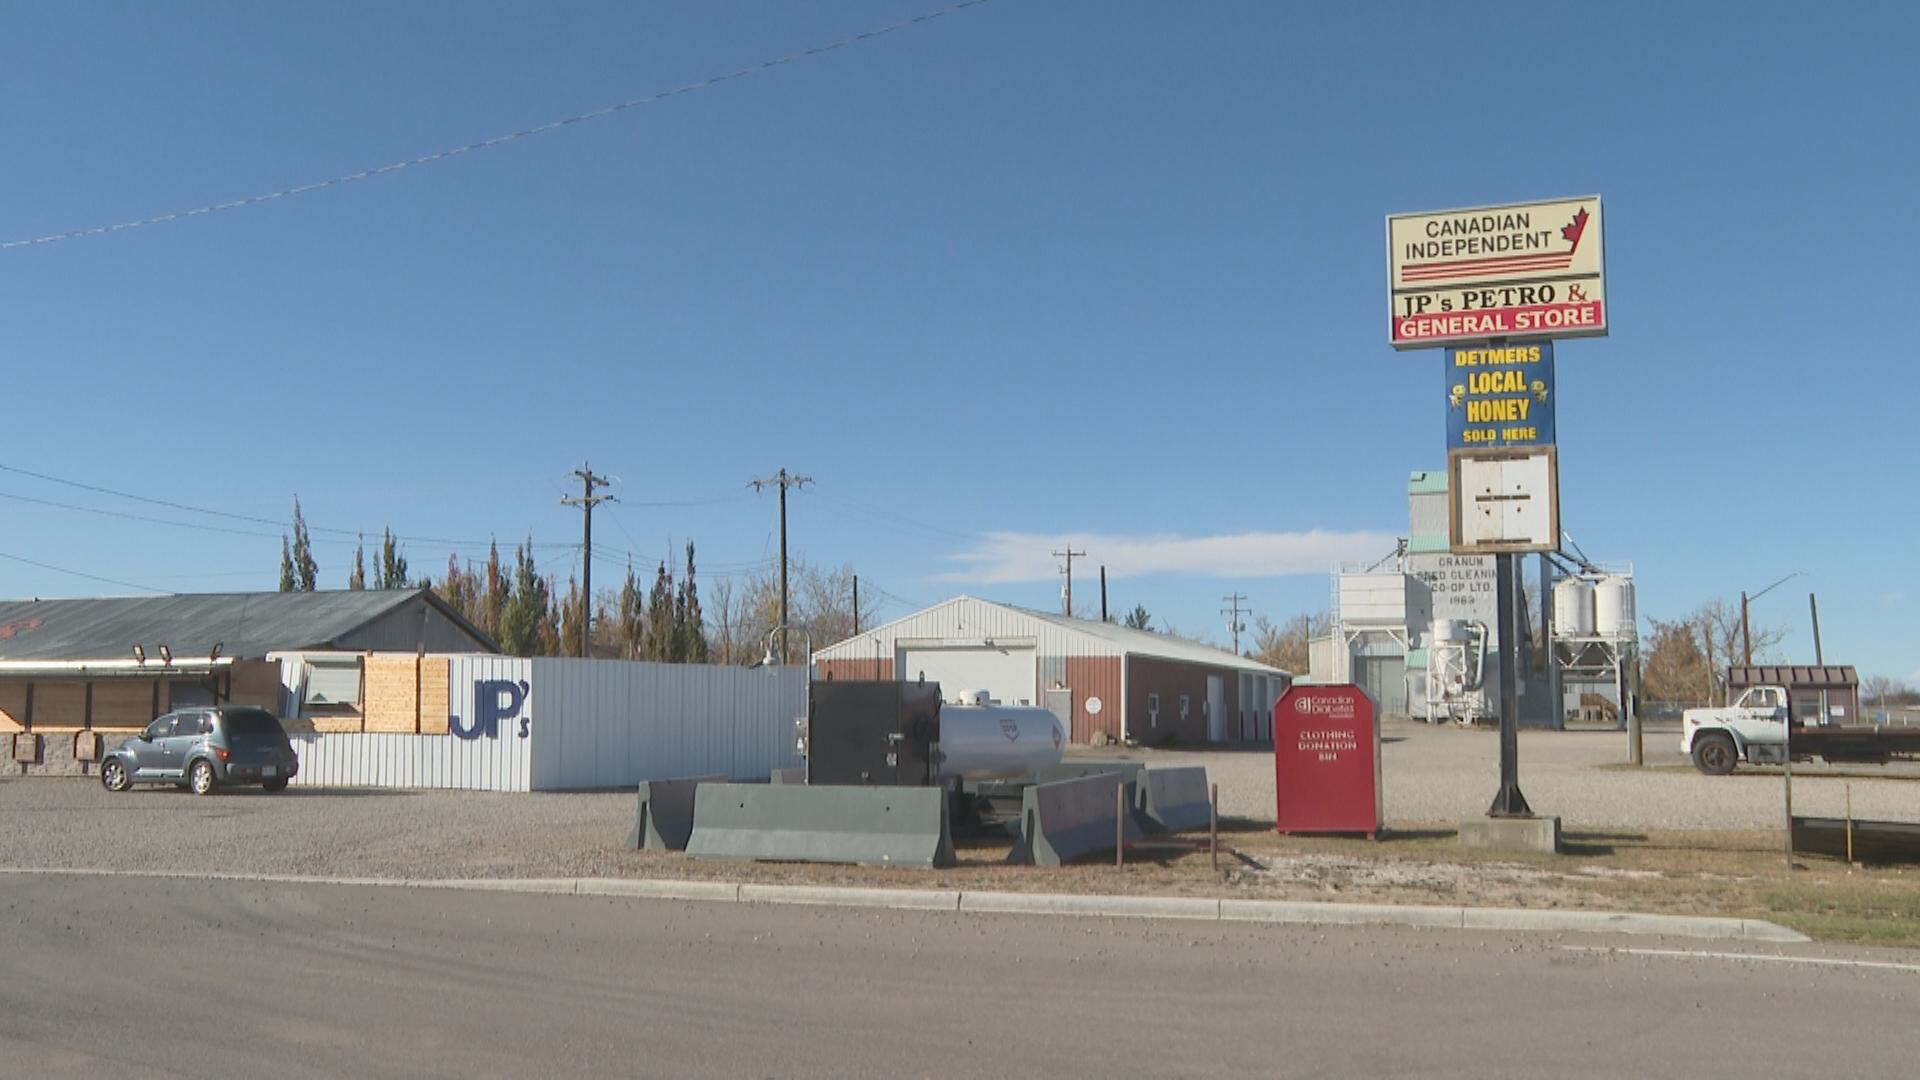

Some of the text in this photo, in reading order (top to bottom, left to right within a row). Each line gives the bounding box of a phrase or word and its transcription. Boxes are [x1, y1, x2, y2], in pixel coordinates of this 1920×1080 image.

[1426, 213, 1530, 238] CANADIAN
[1406, 231, 1552, 260] INDEPENDENT
[1403, 283, 1587, 319] JP's PETRO &
[1400, 306, 1595, 337] GENERAL STORE
[1455, 346, 1541, 367] DETMERS
[1469, 370, 1528, 394] LOCAL
[1467, 399, 1530, 423] HONEY
[1463, 427, 1537, 442] SOLD HERE
[1438, 557, 1484, 567] GRANUM
[1450, 569, 1498, 580] CLEANIN
[1311, 696, 1354, 705] Canadian
[1311, 704, 1354, 714] Diabetes
[1300, 731, 1355, 741] CLOTHING
[1298, 741, 1357, 751] DONATION
[1319, 752, 1338, 761] BIN
